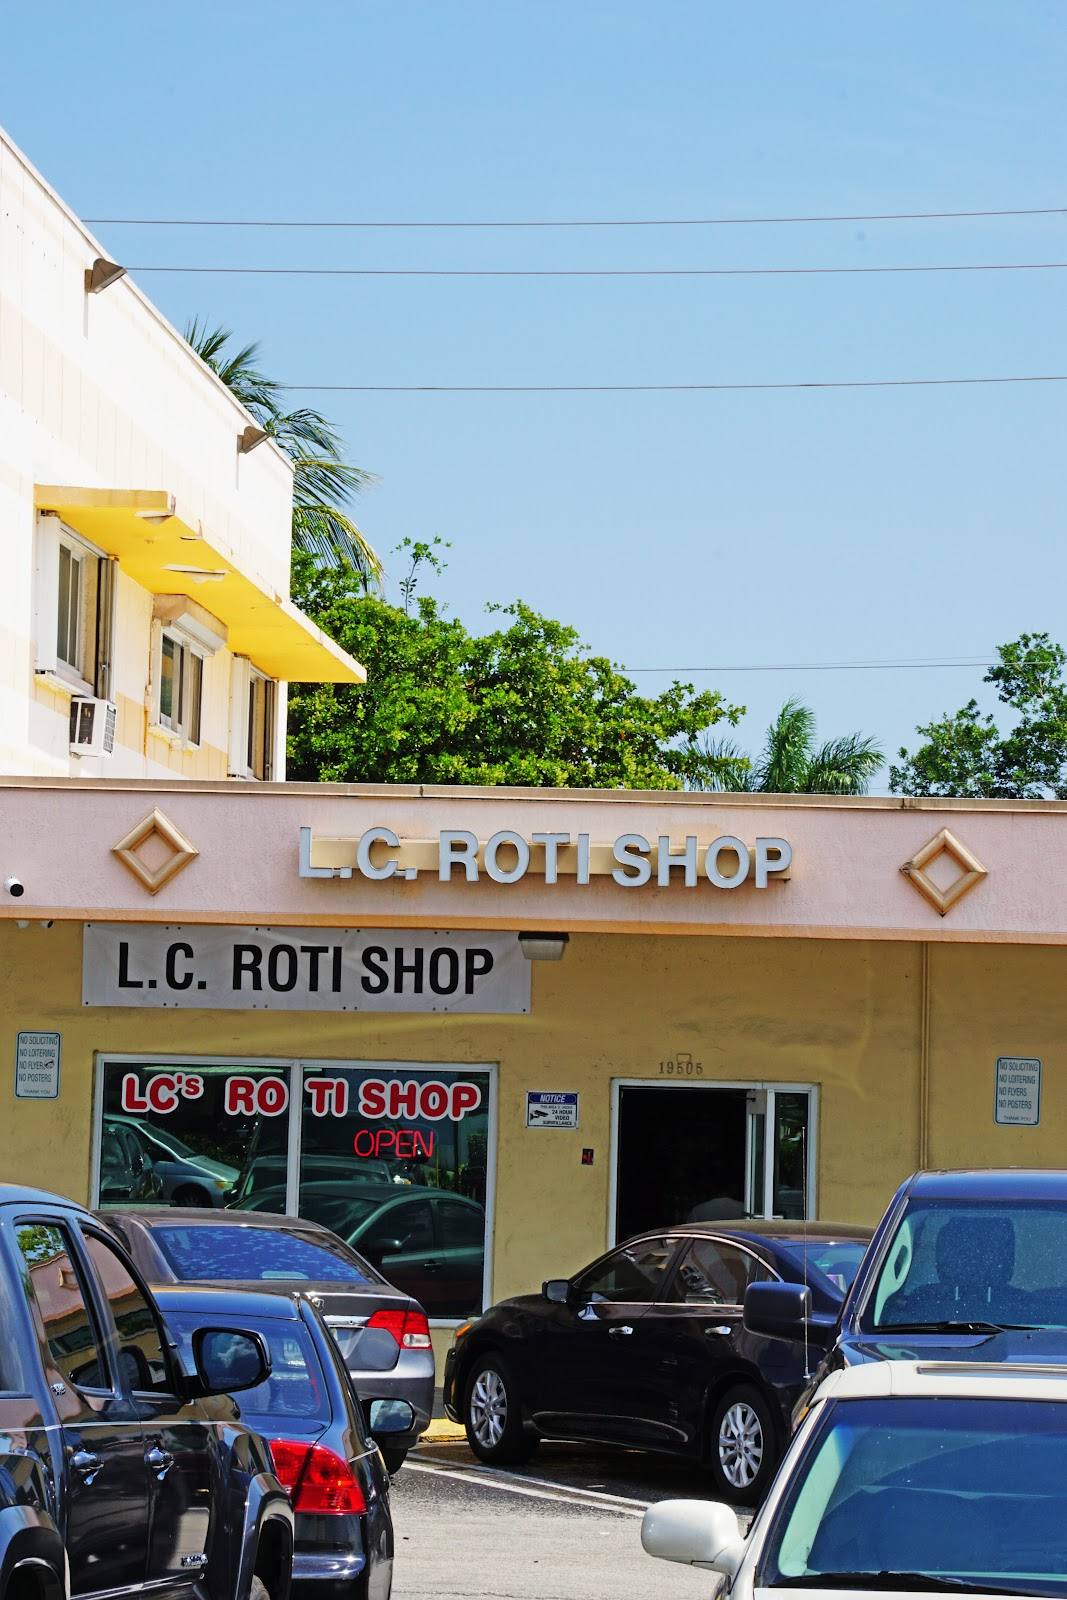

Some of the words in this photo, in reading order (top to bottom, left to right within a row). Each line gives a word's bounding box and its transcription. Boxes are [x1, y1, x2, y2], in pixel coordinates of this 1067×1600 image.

[298, 827, 418, 881] L.C.
[438, 830, 590, 886] ROTI
[611, 833, 792, 889] SHOP
[118, 942, 207, 990] L.C.
[232, 944, 342, 993] ROTI
[361, 946, 494, 995] SHOP
[20, 1036, 28, 1045] NO
[20, 1049, 28, 1057] NO
[19, 1061, 27, 1070] NO
[658, 1061, 704, 1075] 19505
[1000, 1062, 1008, 1071] NO
[1009, 1062, 1039, 1072] SOLICITING
[19, 1073, 27, 1082] NO
[28, 1073, 52, 1082] POSTERS
[1000, 1074, 1008, 1083] NO
[1008, 1074, 1036, 1085] LOITERING
[999, 1087, 1007, 1096] NO
[1008, 1087, 1027, 1097] FLYERS
[358, 1078, 482, 1122] SHOP
[540, 1094, 566, 1103] NOTICE
[999, 1100, 1007, 1109] NO
[1008, 1101, 1032, 1110] POSTERS
[353, 1128, 434, 1158] OPEN
